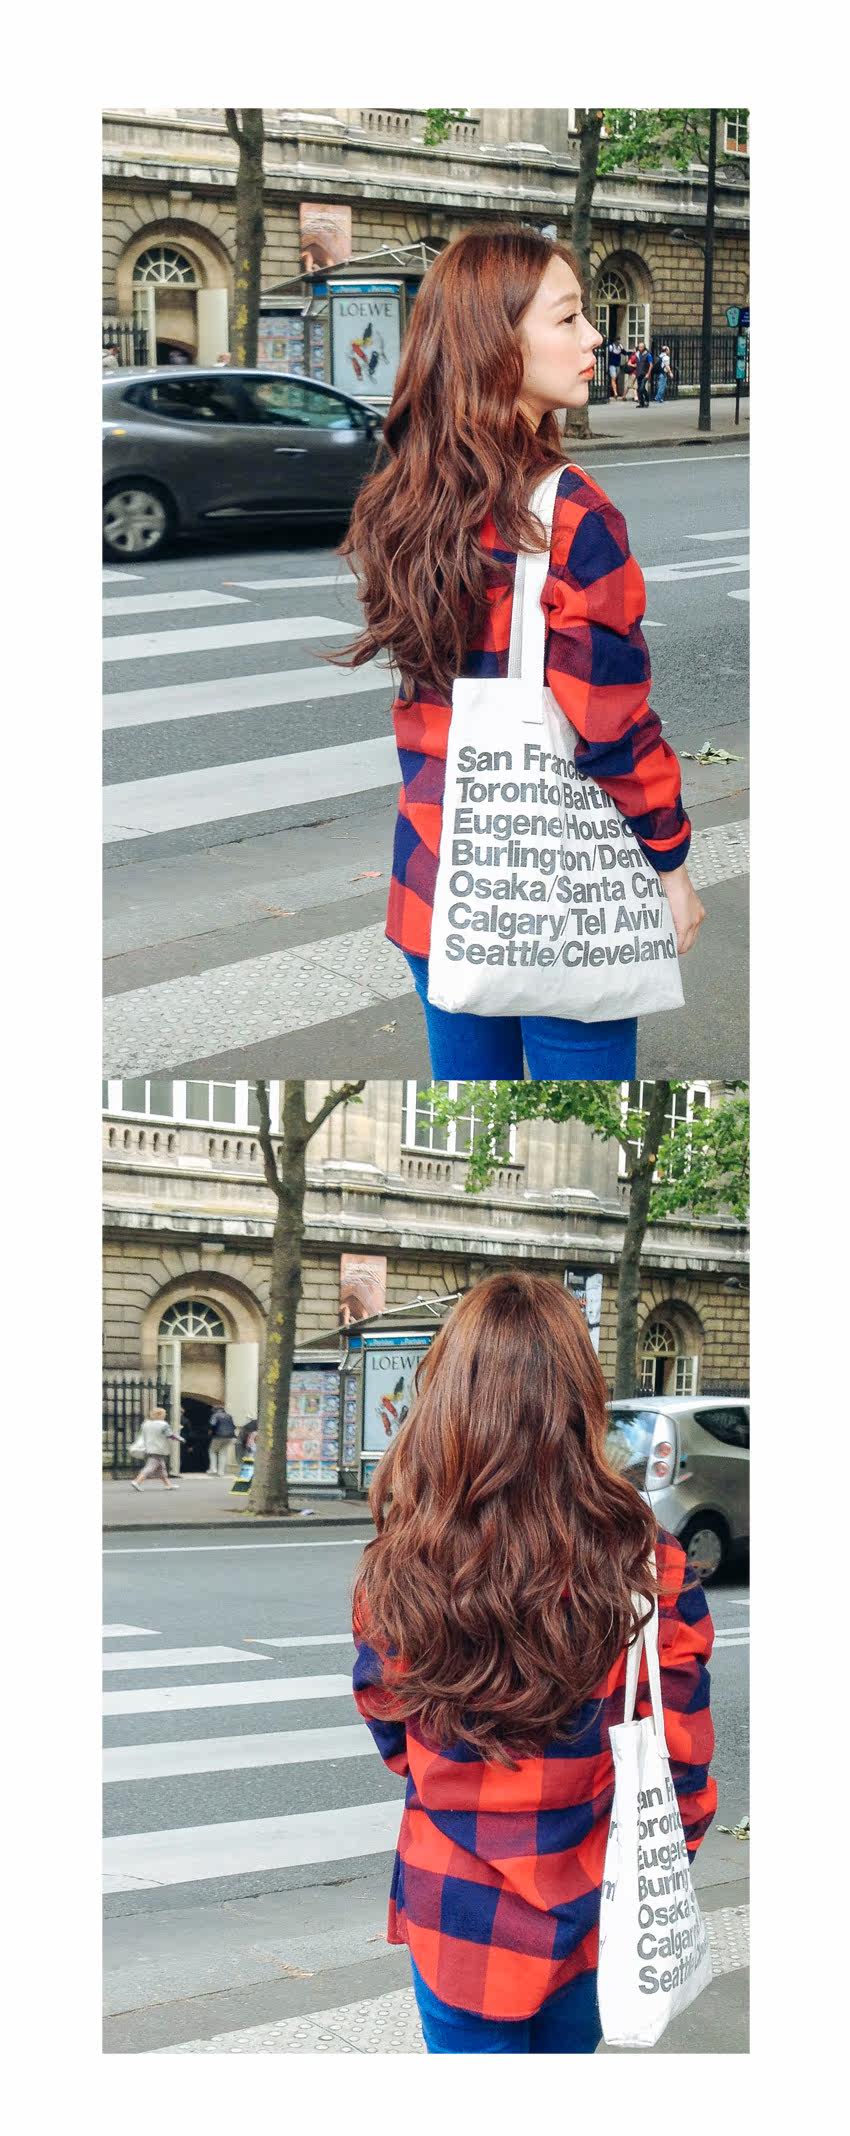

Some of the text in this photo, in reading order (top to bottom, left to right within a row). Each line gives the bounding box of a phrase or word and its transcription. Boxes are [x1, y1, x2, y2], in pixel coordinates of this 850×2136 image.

[340, 303, 393, 317] LOEWE
[457, 745, 513, 773] San
[631, 871, 668, 899] Cru
